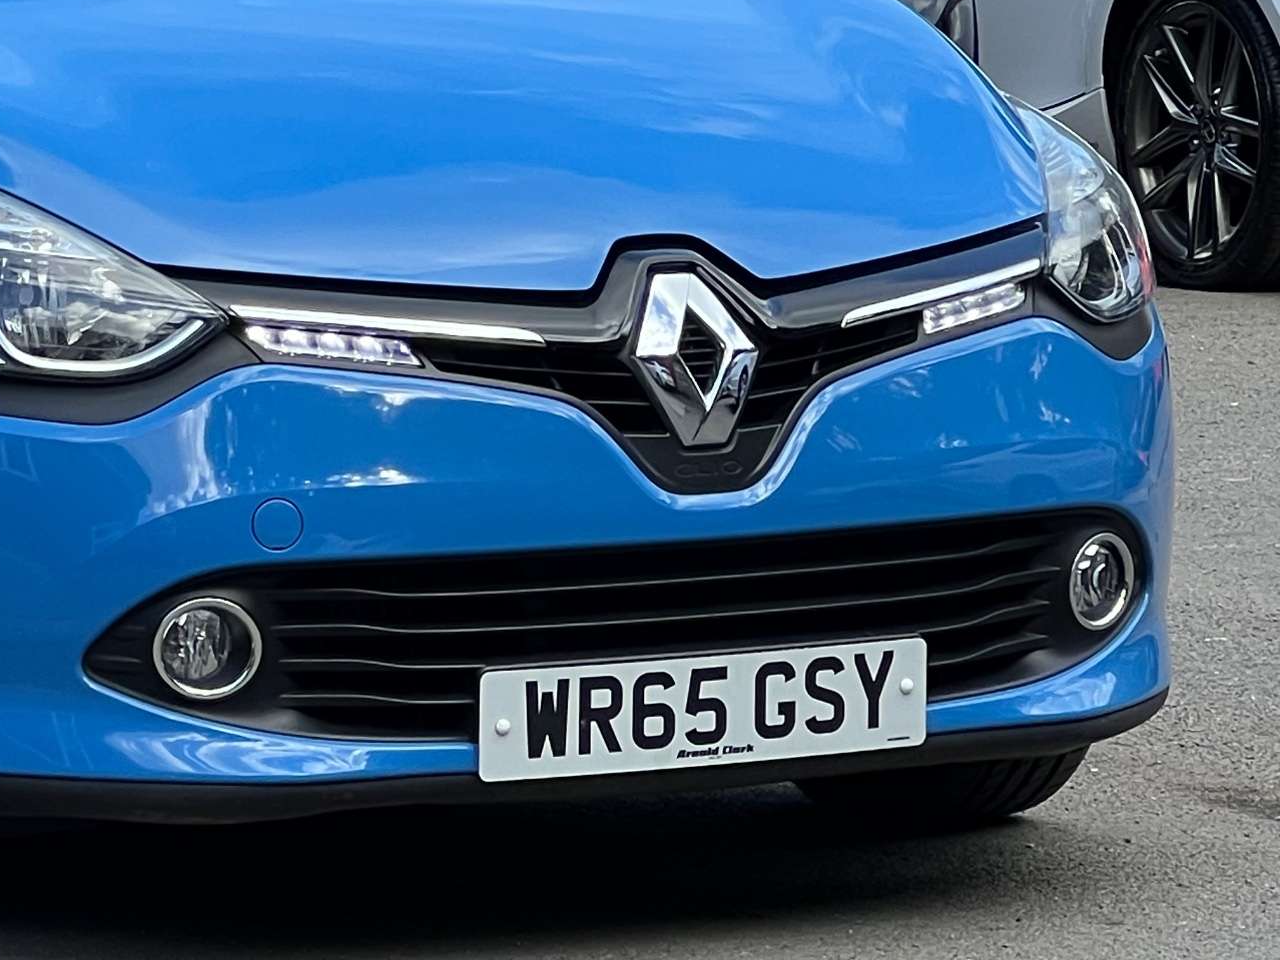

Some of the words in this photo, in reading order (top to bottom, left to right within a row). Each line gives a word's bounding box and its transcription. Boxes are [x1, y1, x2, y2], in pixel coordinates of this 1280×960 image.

[526, 666, 728, 760] WR65
[753, 649, 895, 740] GSY
[676, 746, 719, 759] Arnold
[722, 744, 754, 755] Clark
